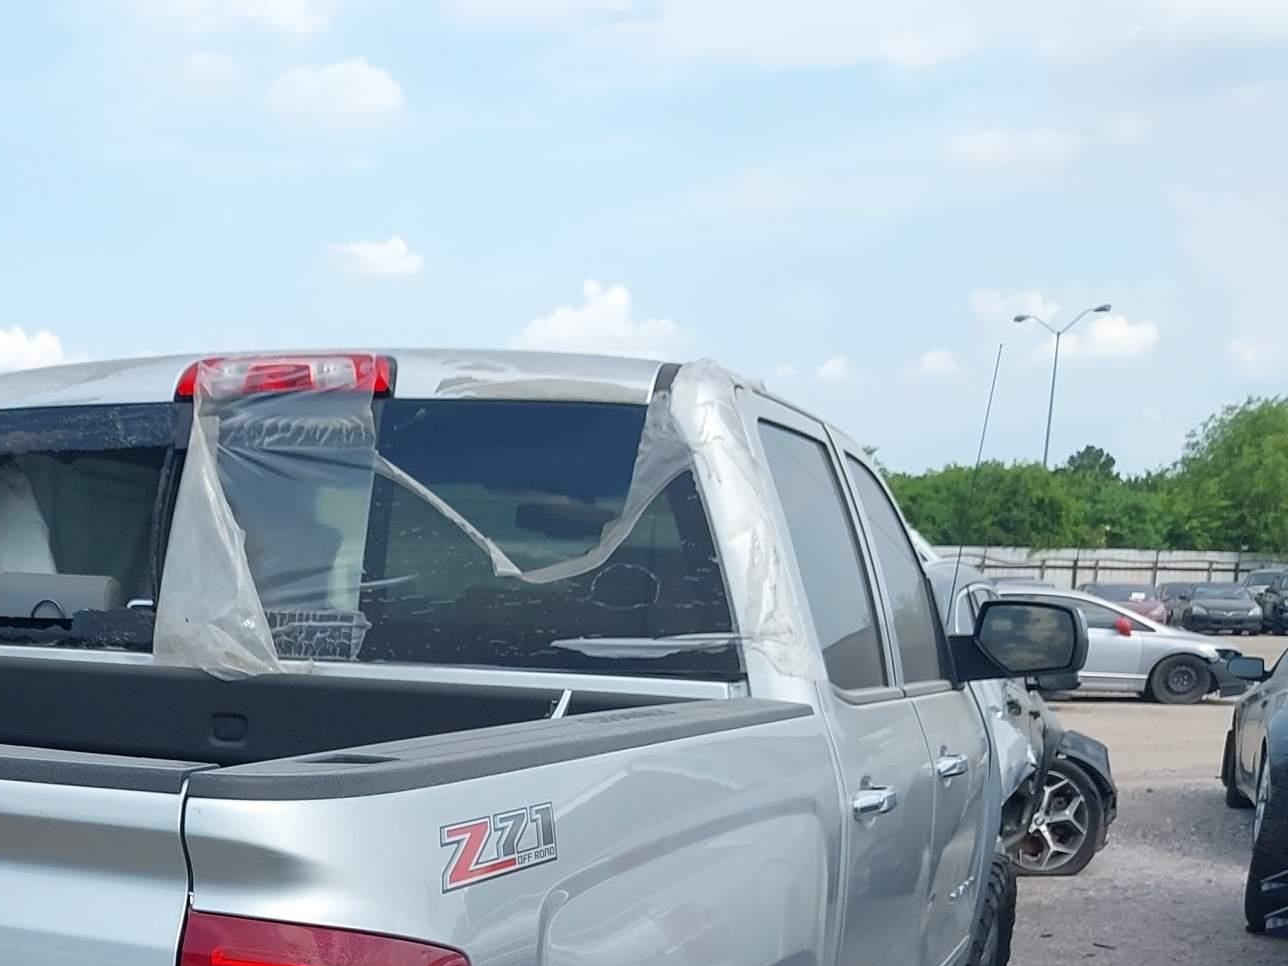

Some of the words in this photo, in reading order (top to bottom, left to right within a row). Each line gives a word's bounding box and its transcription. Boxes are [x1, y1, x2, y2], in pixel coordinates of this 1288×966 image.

[440, 801, 557, 894] Z71
[517, 852, 533, 865] OFF
[534, 846, 555, 860] ROAD
